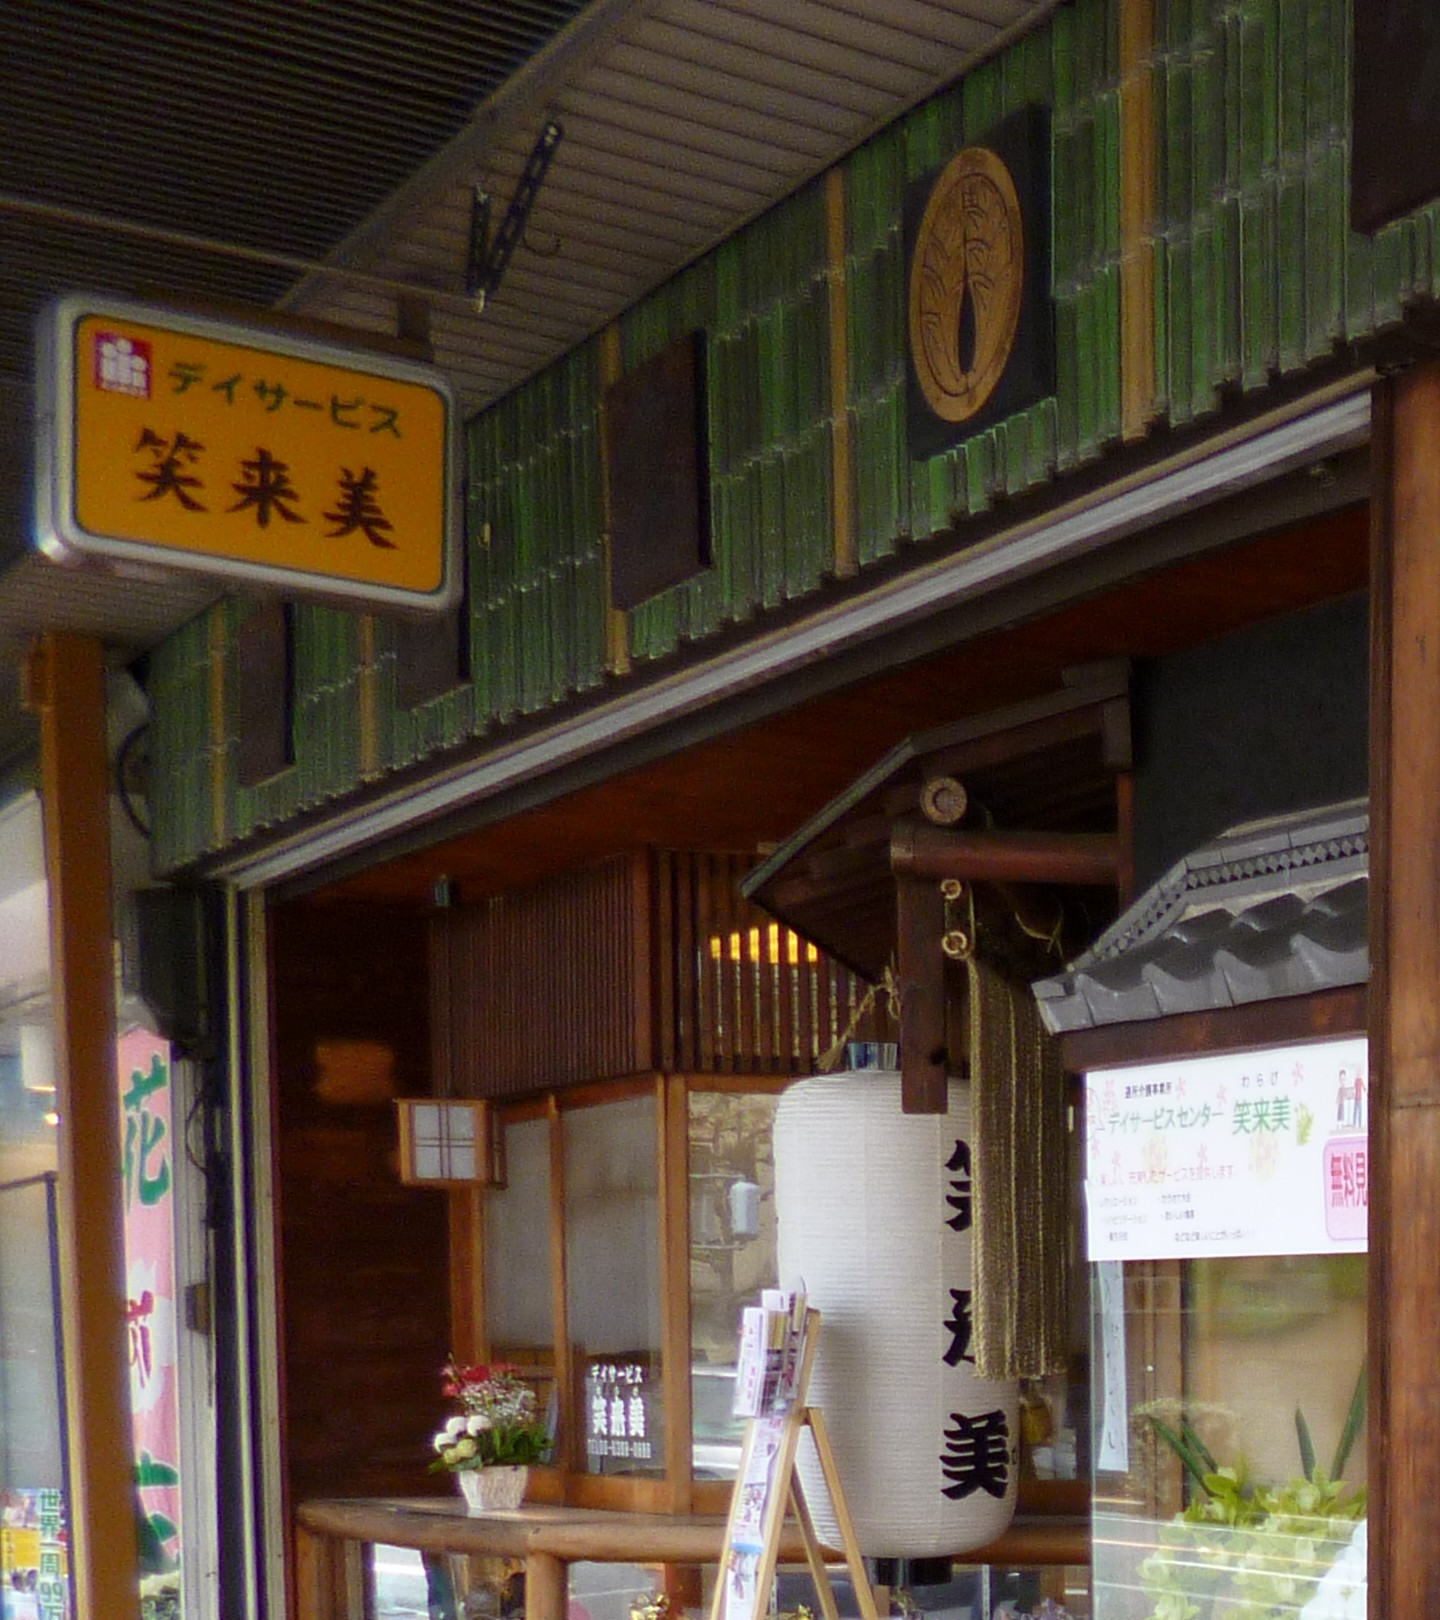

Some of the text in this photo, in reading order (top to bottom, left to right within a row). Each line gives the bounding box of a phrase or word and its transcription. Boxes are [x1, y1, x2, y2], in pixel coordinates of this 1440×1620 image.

[167, 362, 402, 438] デイサービス
[134, 427, 398, 550] 笑来美
[1107, 1093, 1291, 1137] デイサービスセンター 笑来美
